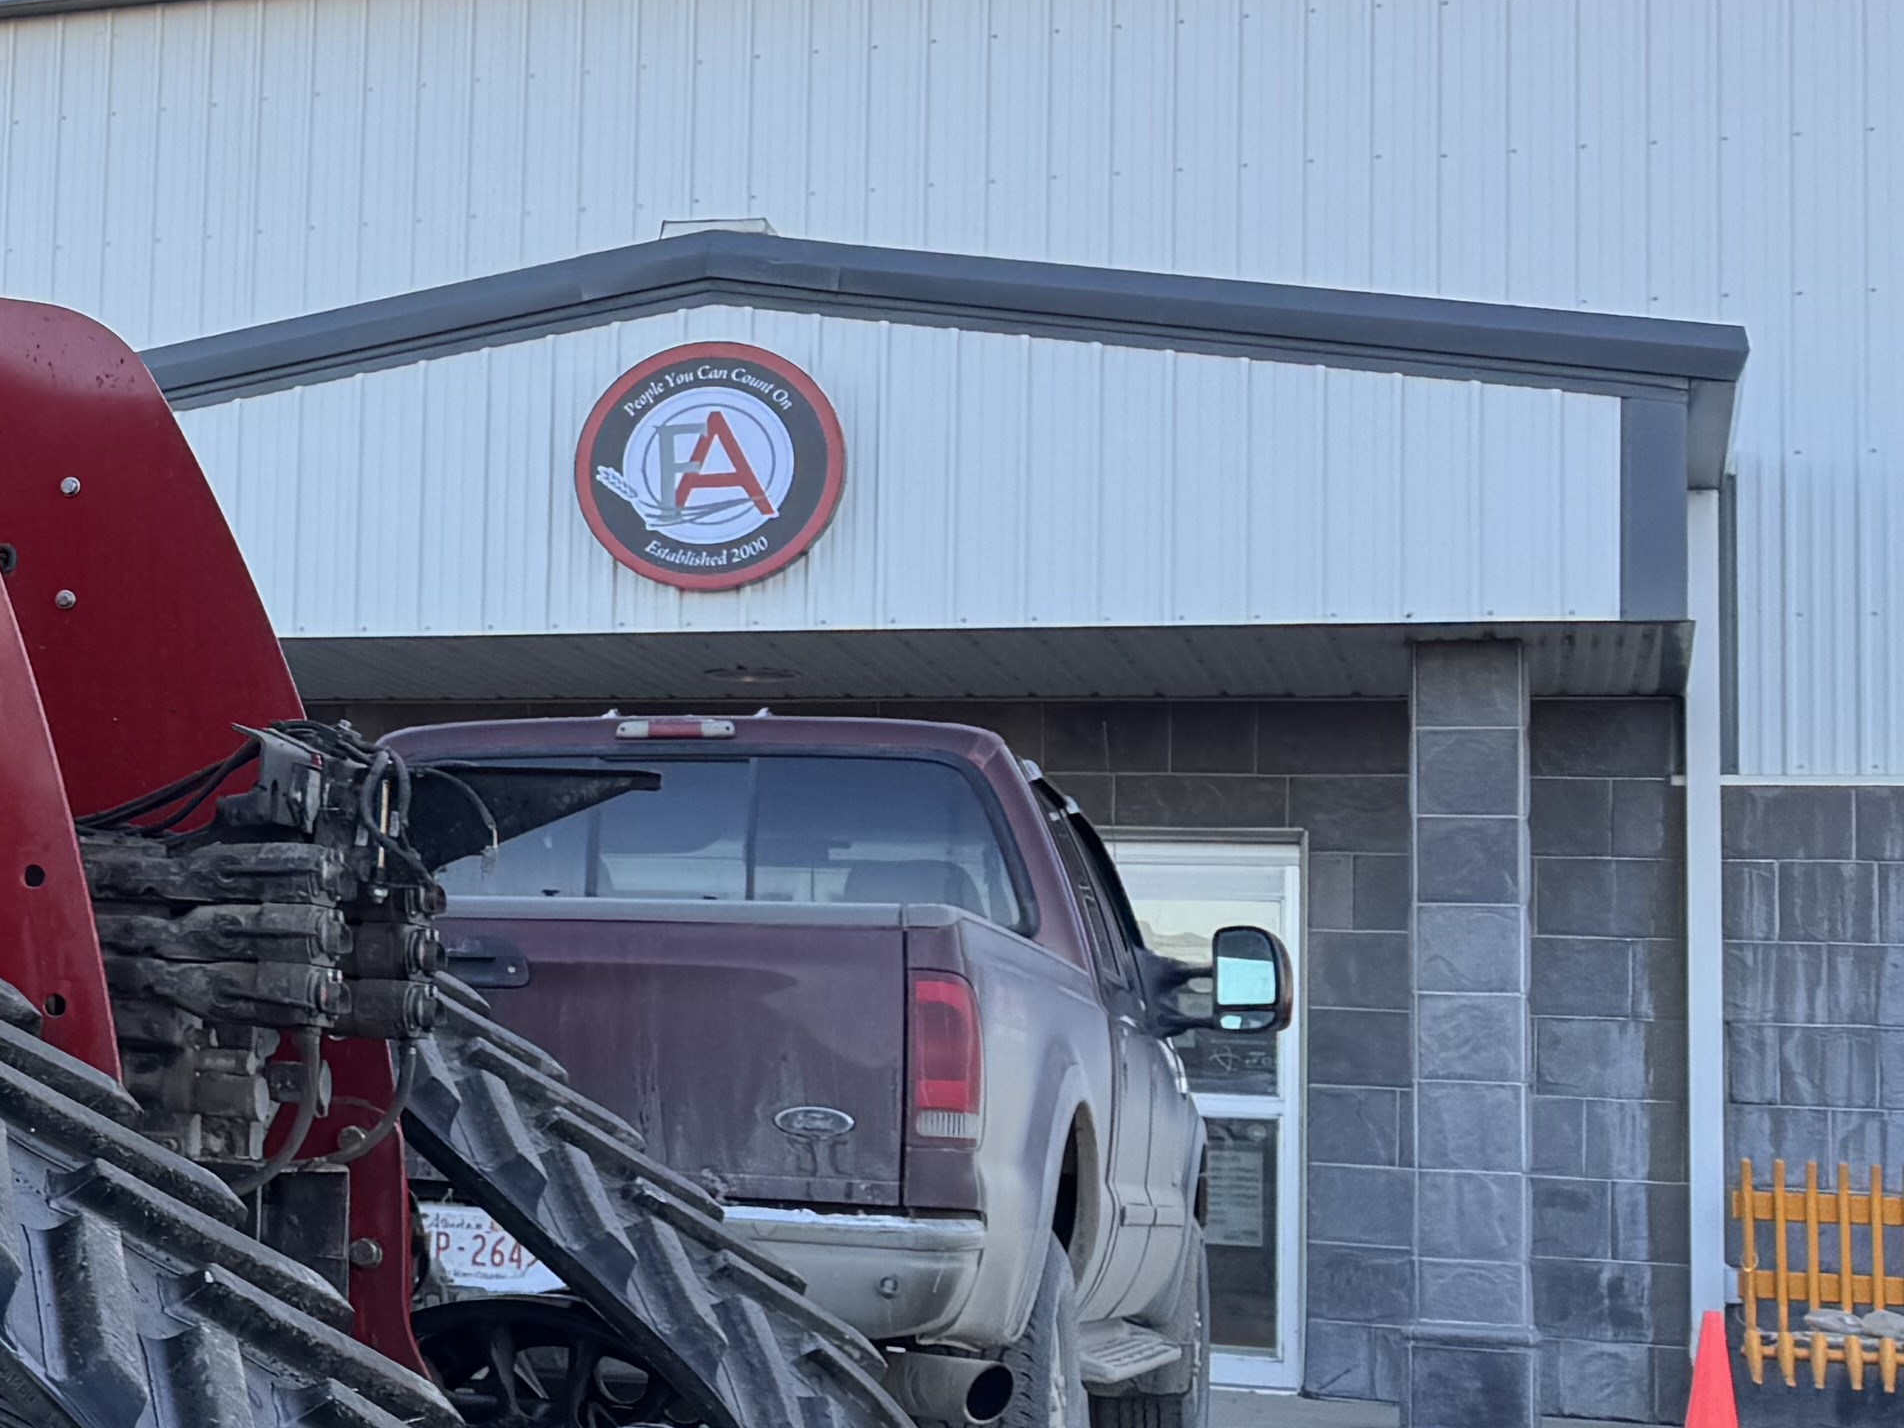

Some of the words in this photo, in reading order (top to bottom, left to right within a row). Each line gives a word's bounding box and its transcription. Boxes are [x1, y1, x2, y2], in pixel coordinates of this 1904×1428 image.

[623, 380, 665, 418] People
[664, 370, 694, 390] You
[696, 364, 729, 380] Can
[731, 367, 775, 395] Count
[772, 387, 794, 411] On
[644, 539, 728, 567] Established
[731, 535, 769, 563] 2000
